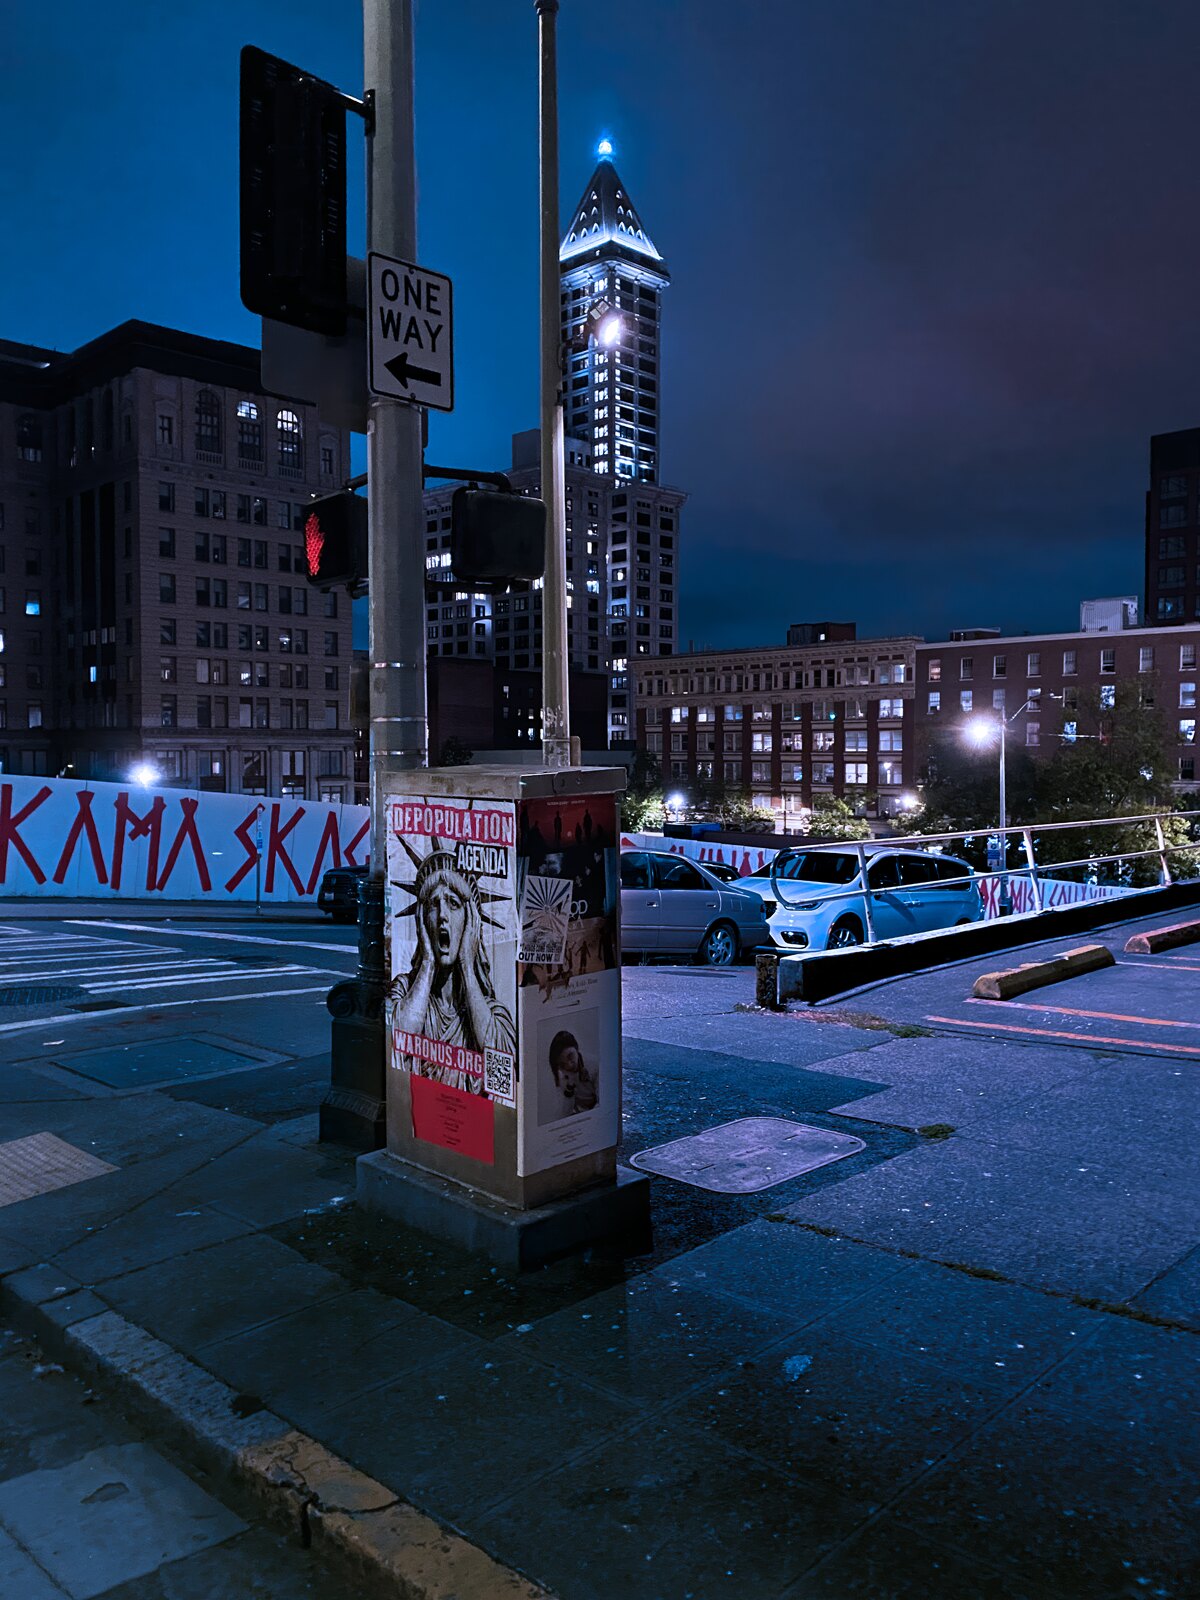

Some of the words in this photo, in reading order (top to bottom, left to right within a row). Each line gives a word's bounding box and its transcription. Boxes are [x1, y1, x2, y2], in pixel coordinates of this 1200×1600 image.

[381, 269, 441, 316] ONE
[380, 306, 443, 353] WAY
[393, 806, 513, 843] DEPOPULATION
[457, 844, 507, 876] AGENDA
[518, 952, 535, 961] OUT
[536, 953, 553, 962] NOW
[395, 1030, 482, 1074] WARONUS.ORG
